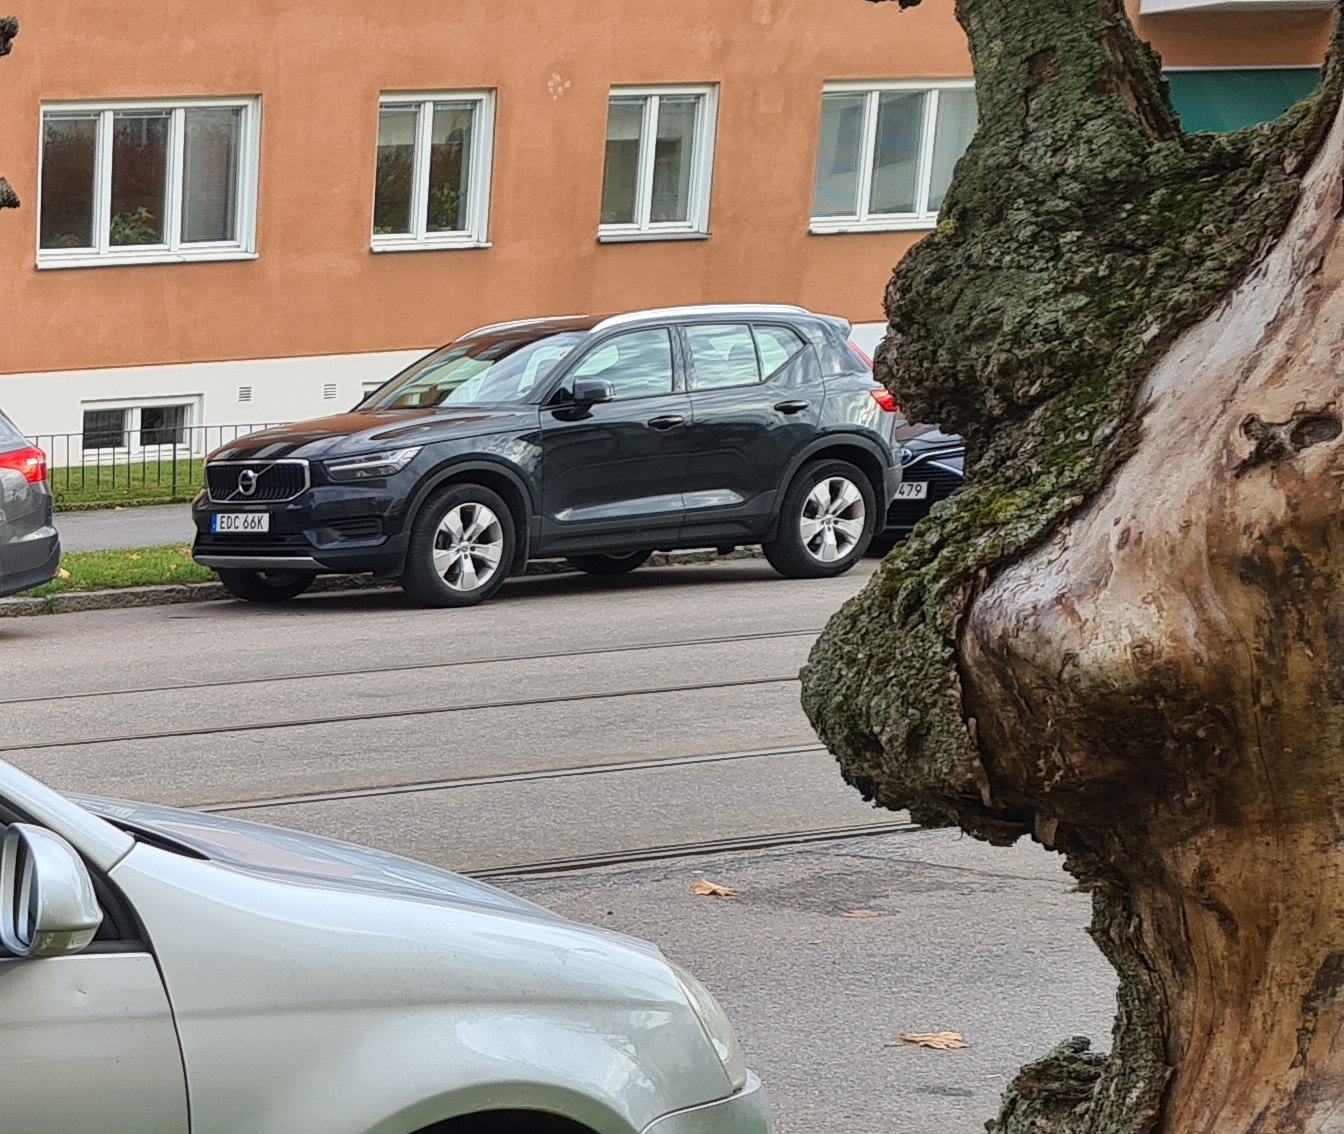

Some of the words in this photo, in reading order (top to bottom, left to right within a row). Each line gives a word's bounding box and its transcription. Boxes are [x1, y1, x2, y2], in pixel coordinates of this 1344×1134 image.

[898, 483, 923, 497] 479
[219, 515, 240, 530] EDC
[242, 514, 264, 530] 66K
